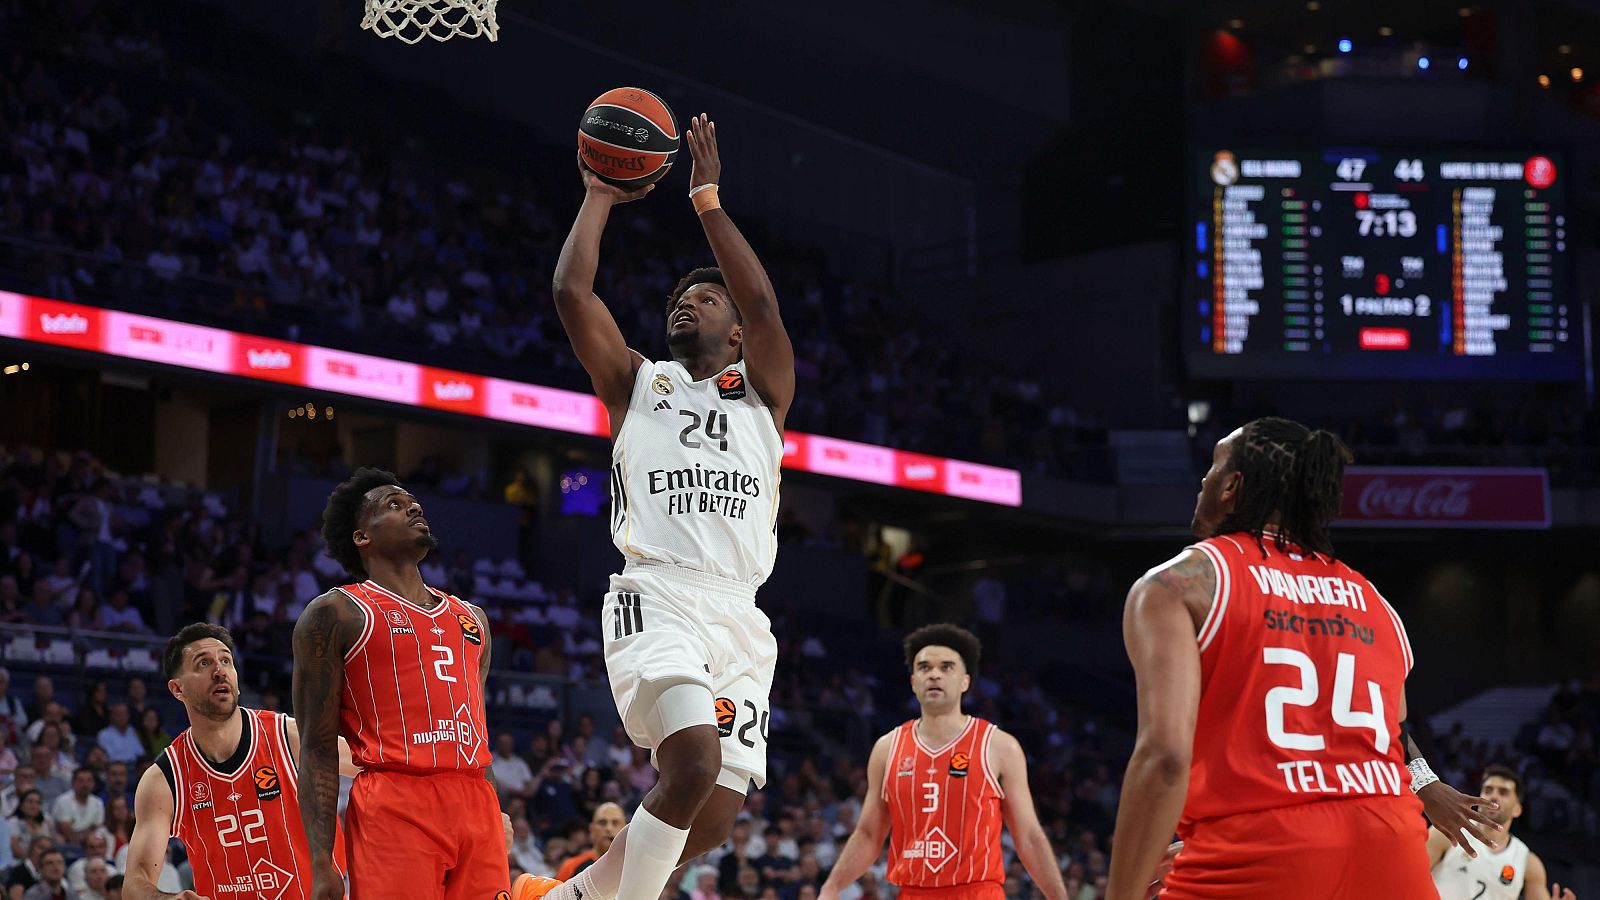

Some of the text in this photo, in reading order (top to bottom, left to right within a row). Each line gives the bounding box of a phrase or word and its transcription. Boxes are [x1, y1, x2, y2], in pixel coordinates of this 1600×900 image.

[581, 139, 646, 171] SPALDING
[1336, 158, 1366, 181] 47
[1394, 159, 1425, 182] 44
[1355, 210, 1417, 237] 7:13
[1415, 294, 1431, 317] 2
[679, 409, 728, 451] 24
[647, 462, 760, 498] Emirates
[668, 491, 747, 520] FLY BETTER
[1248, 565, 1367, 612] WANRIGHT
[431, 645, 457, 683] 2
[1263, 647, 1391, 755] 24
[413, 730, 456, 744] השקעות
[437, 719, 455, 730] בית
[1277, 759, 1401, 796] TEL AVIV
[193, 801, 212, 811] RTMI
[922, 782, 940, 813] 3
[214, 809, 268, 848] 22
[253, 872, 280, 890] IBI
